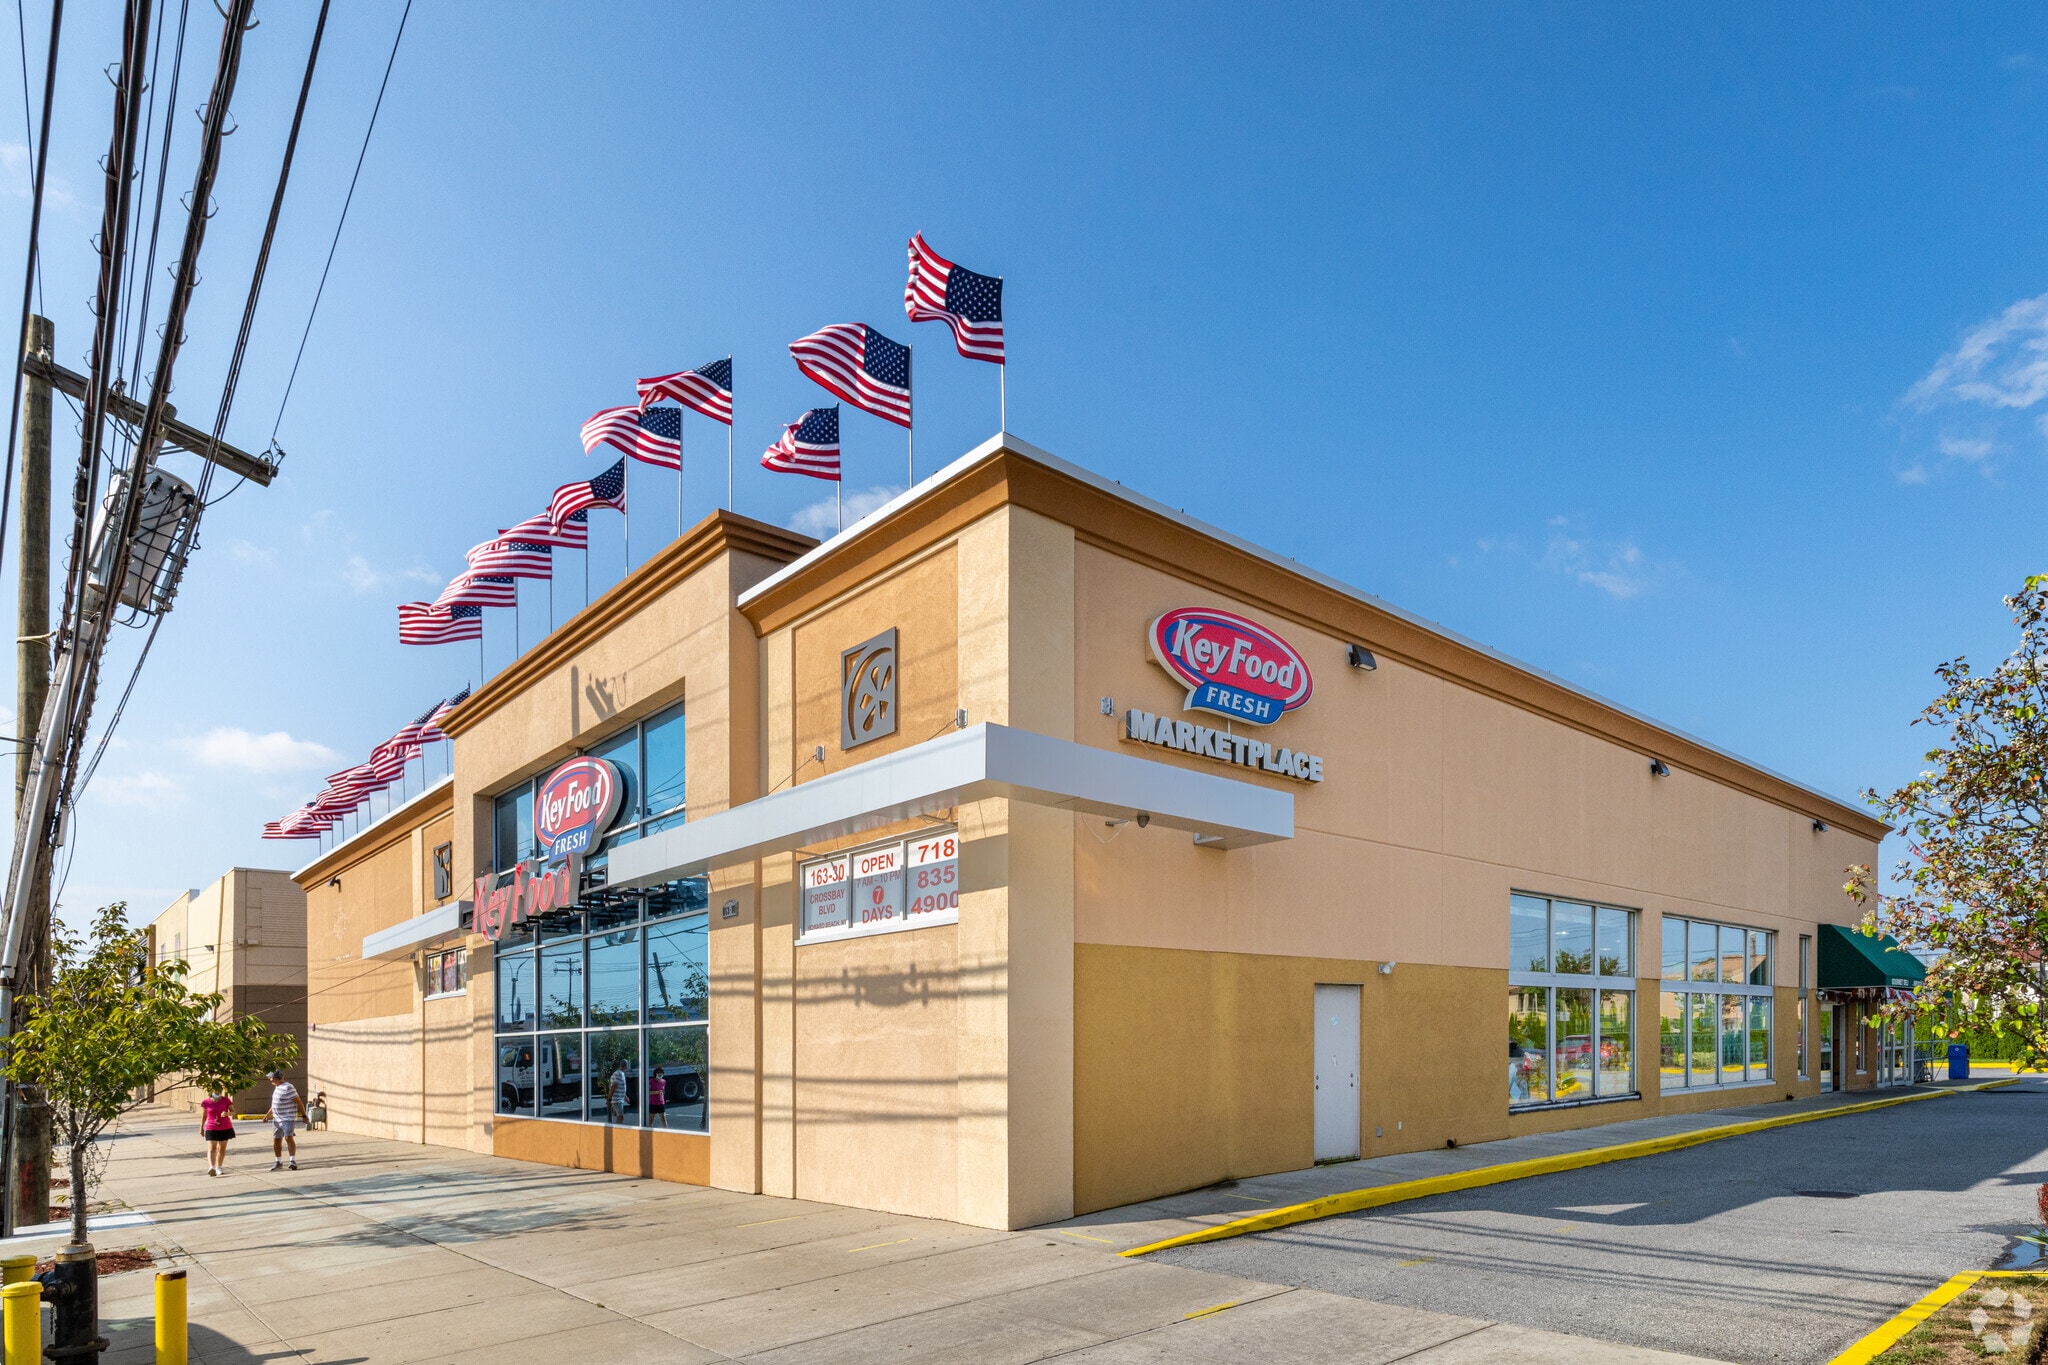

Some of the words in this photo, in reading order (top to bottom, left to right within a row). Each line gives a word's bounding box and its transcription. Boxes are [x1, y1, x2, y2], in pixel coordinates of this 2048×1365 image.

[1206, 686, 1270, 718] FRESH
[1127, 708, 1324, 782] MARKETPLACE
[554, 829, 587, 856] FRESH
[918, 838, 955, 863] 718
[811, 863, 845, 886] 163-30
[861, 853, 894, 874] OPEN
[856, 879, 860, 888] 7
[862, 876, 874, 887] AM
[879, 873, 888, 883] 10
[889, 870, 901, 881] PM
[917, 864, 955, 889] 835
[809, 888, 846, 904] CROSSBAY
[911, 890, 958, 915] 4900
[818, 903, 836, 915] BLVD
[862, 904, 893, 924] DAYS
